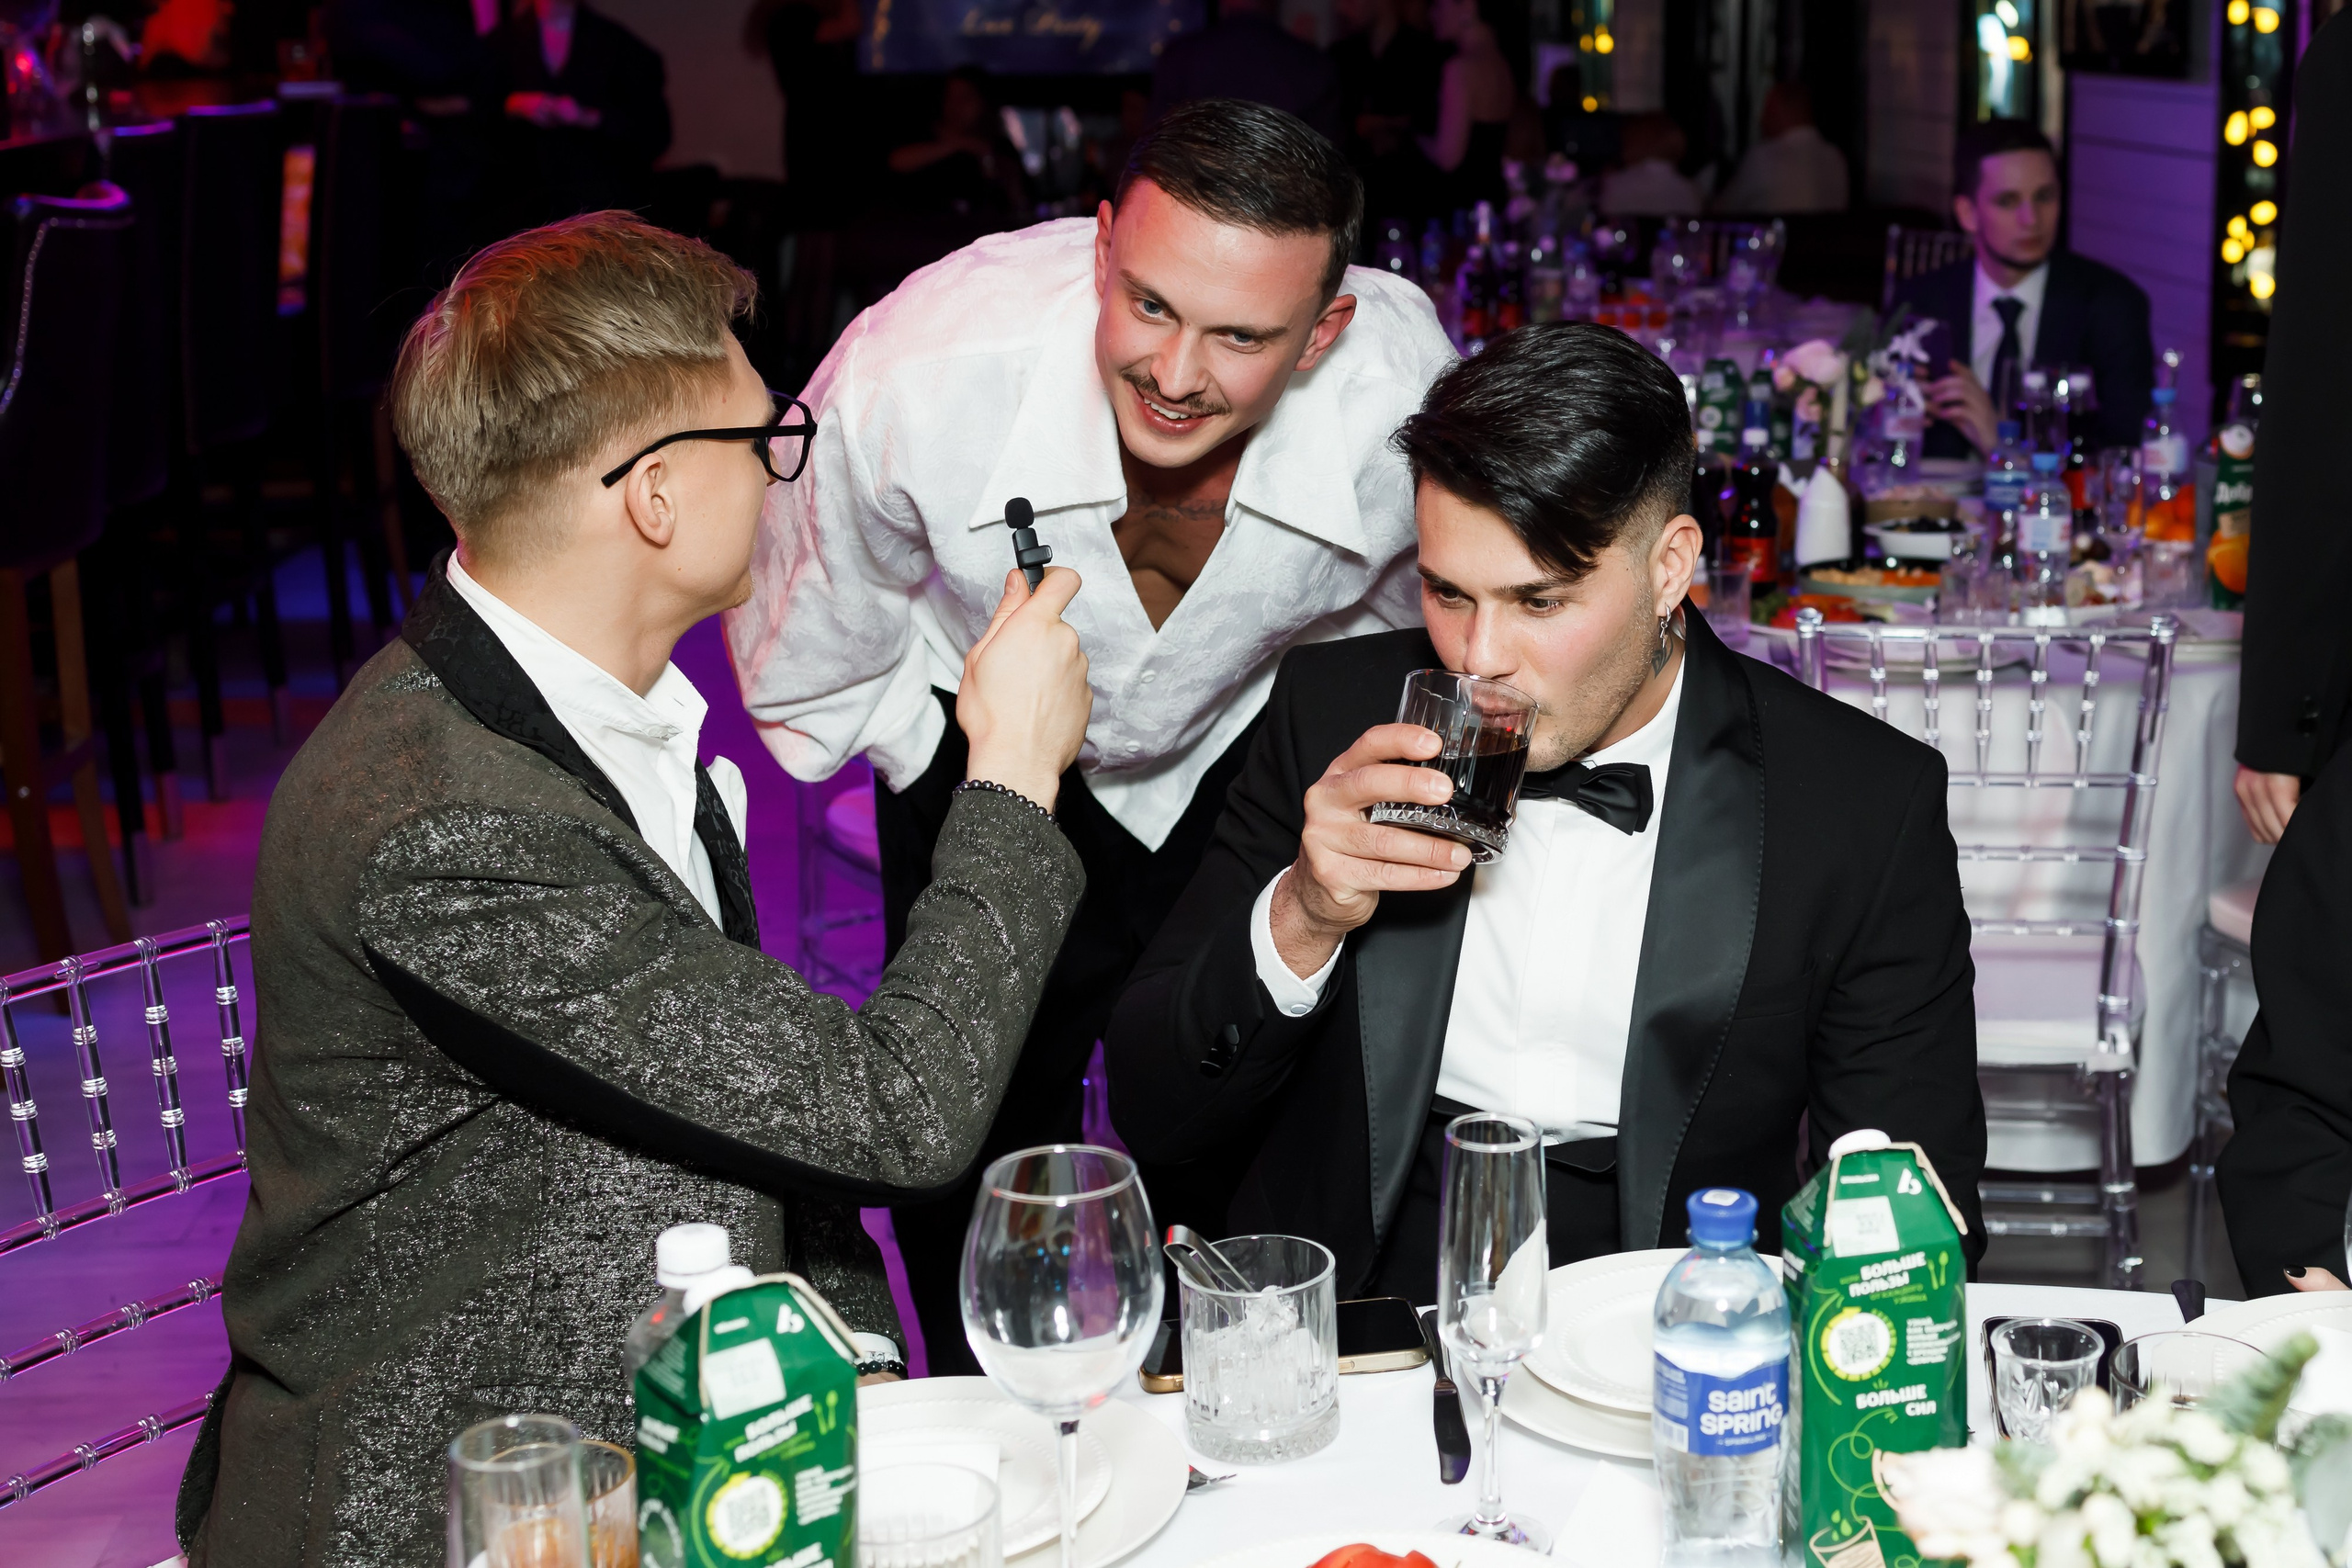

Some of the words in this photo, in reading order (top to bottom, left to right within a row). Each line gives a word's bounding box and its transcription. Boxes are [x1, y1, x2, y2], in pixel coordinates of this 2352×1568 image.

[1860, 1251, 1927, 1280] БОЛЬШЕ
[1849, 1270, 1909, 1298] ПОЛЬЗЫ
[1856, 1383, 1928, 1409] БОЛЬШЕ
[1905, 1400, 1937, 1416] СИЛ
